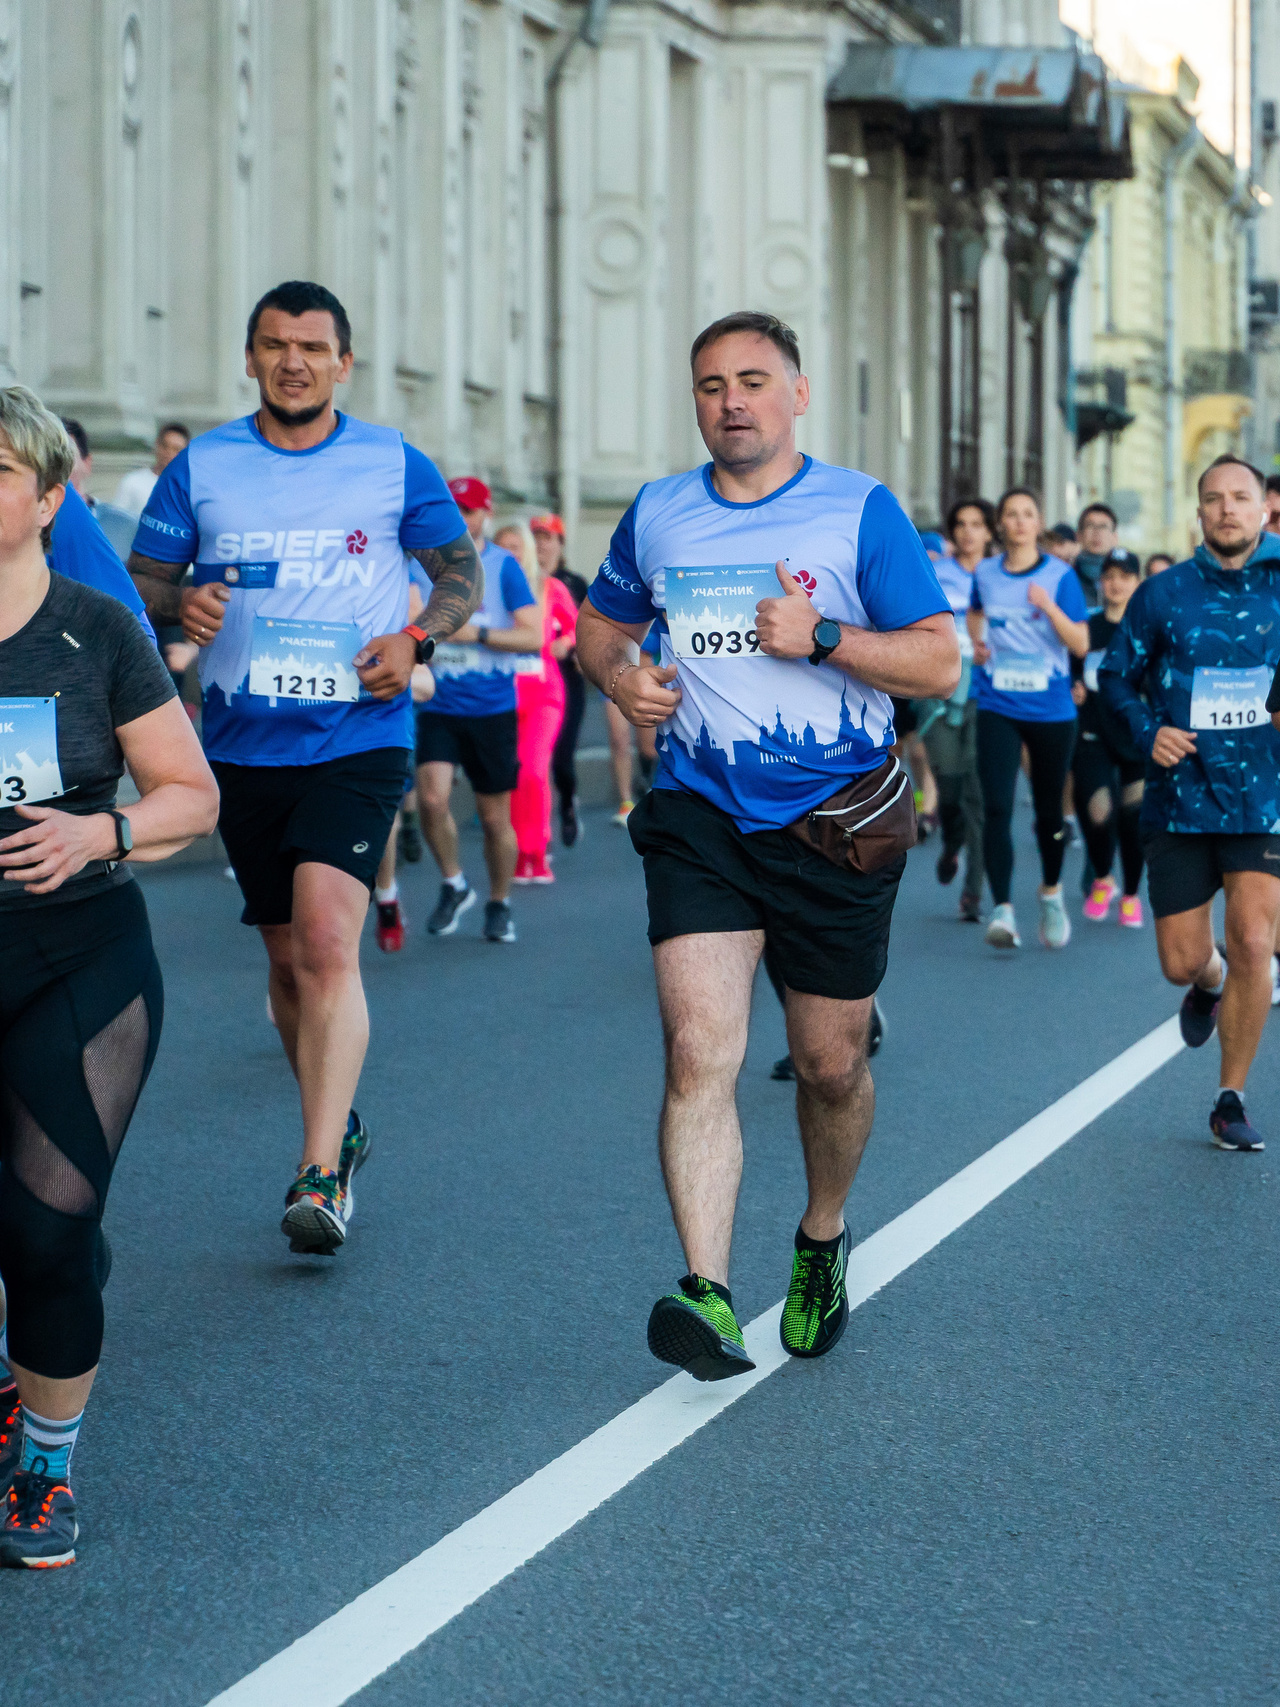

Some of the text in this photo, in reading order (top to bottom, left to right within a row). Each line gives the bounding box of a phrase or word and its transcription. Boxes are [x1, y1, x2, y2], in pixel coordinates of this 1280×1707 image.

[215, 529, 346, 561] SPIEF
[277, 560, 376, 588] RUN
[691, 586, 754, 597] УЧАСТНИК
[279, 636, 336, 648] УЧАСТНИК
[691, 630, 761, 655] 0939
[272, 674, 336, 697] 1213
[1209, 709, 1257, 727] 1410
